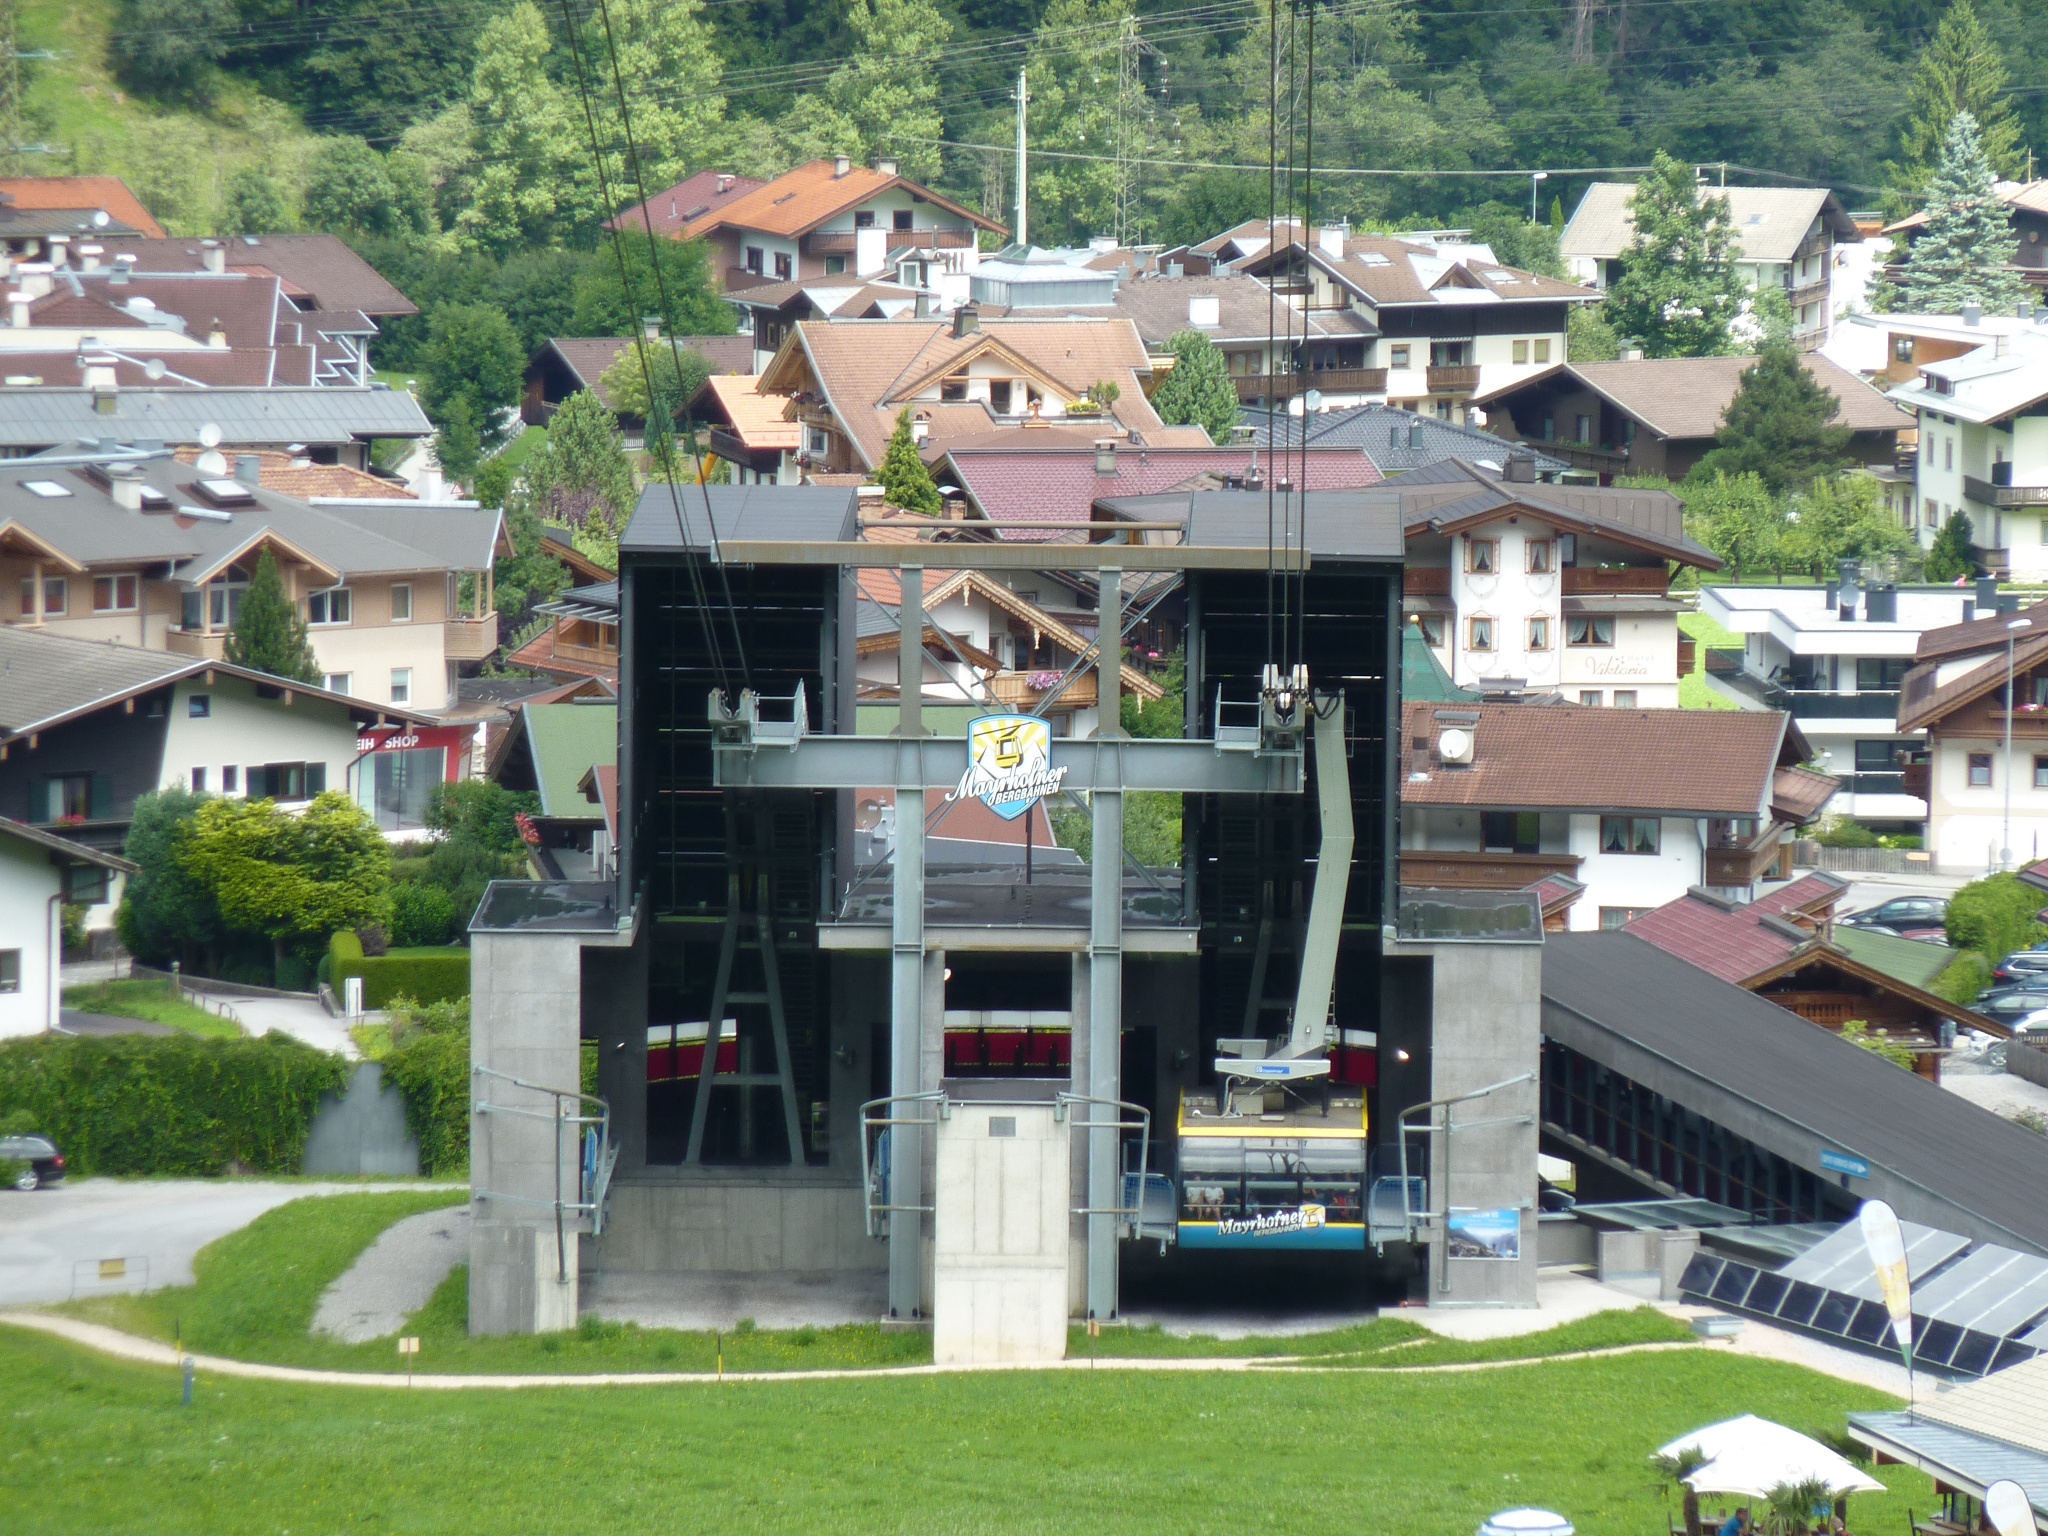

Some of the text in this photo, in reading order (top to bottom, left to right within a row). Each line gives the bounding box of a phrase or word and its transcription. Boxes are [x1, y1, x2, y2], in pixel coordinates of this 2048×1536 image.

[1585, 655, 1648, 675] Viktoria
[385, 735, 419, 749] SHOP
[945, 757, 1068, 806] Mayrhofner
[994, 781, 1060, 805] BERGBAHNEN
[1217, 1210, 1306, 1236] Mayrhofner
[1253, 1223, 1301, 1238] BERGBAHNEN
